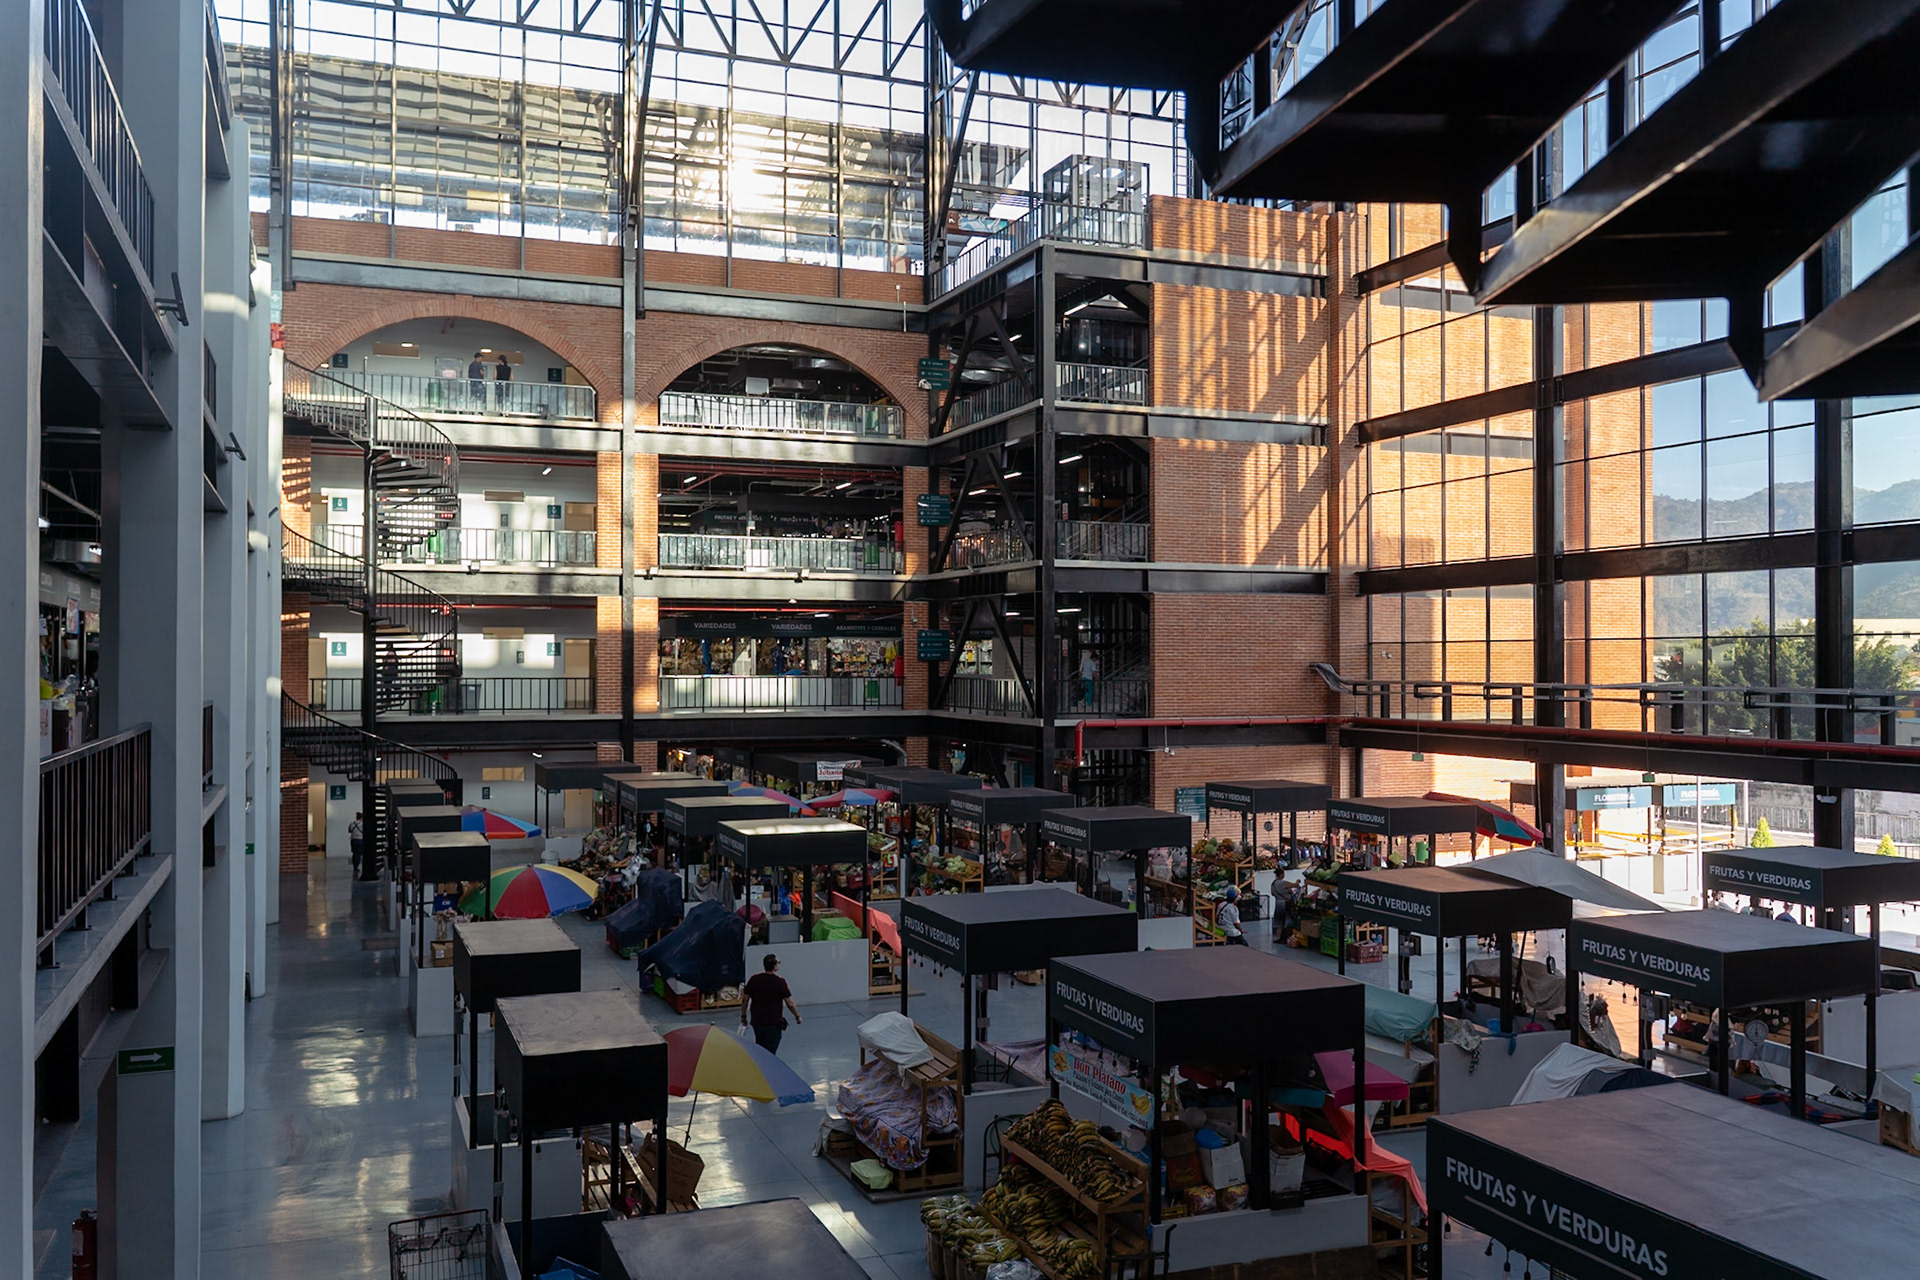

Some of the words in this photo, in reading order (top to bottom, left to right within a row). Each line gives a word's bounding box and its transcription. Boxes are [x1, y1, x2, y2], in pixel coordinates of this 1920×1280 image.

[693, 622, 737, 630] VARIEDADES
[1209, 790, 1224, 799] FRUTAS
[1228, 793, 1251, 803] VERDURAS
[1044, 820, 1060, 831] FRUTAS
[1064, 824, 1087, 838] VERDURAS
[1331, 808, 1350, 819] FRUTAS
[1351, 811, 1355, 819] Y
[1356, 812, 1385, 824] VERDURAS
[1709, 865, 1745, 879] FRUTAS
[1746, 870, 1755, 881] Y
[1756, 871, 1812, 890] VERDURAS
[1345, 889, 1376, 904] FRUTAS
[1376, 895, 1384, 906] Y
[1384, 896, 1432, 917] VERDURAS
[904, 914, 924, 934] FRUTAS
[924, 923, 929, 936] Y
[929, 925, 960, 950] VERDURAS
[1582, 938, 1626, 961] FRUTAS
[1628, 949, 1638, 963] Y
[1640, 952, 1711, 982] VERDURAS
[1056, 980, 1087, 1007] FRUTAS
[1087, 994, 1094, 1011] Y
[1094, 997, 1145, 1034] VERDURAS
[1074, 1057, 1090, 1076] Don
[1093, 1066, 1126, 1094] Platano
[1446, 1156, 1517, 1208] FRUTAS
[1521, 1190, 1537, 1216] Y
[1541, 1199, 1669, 1277] VERDURAS
